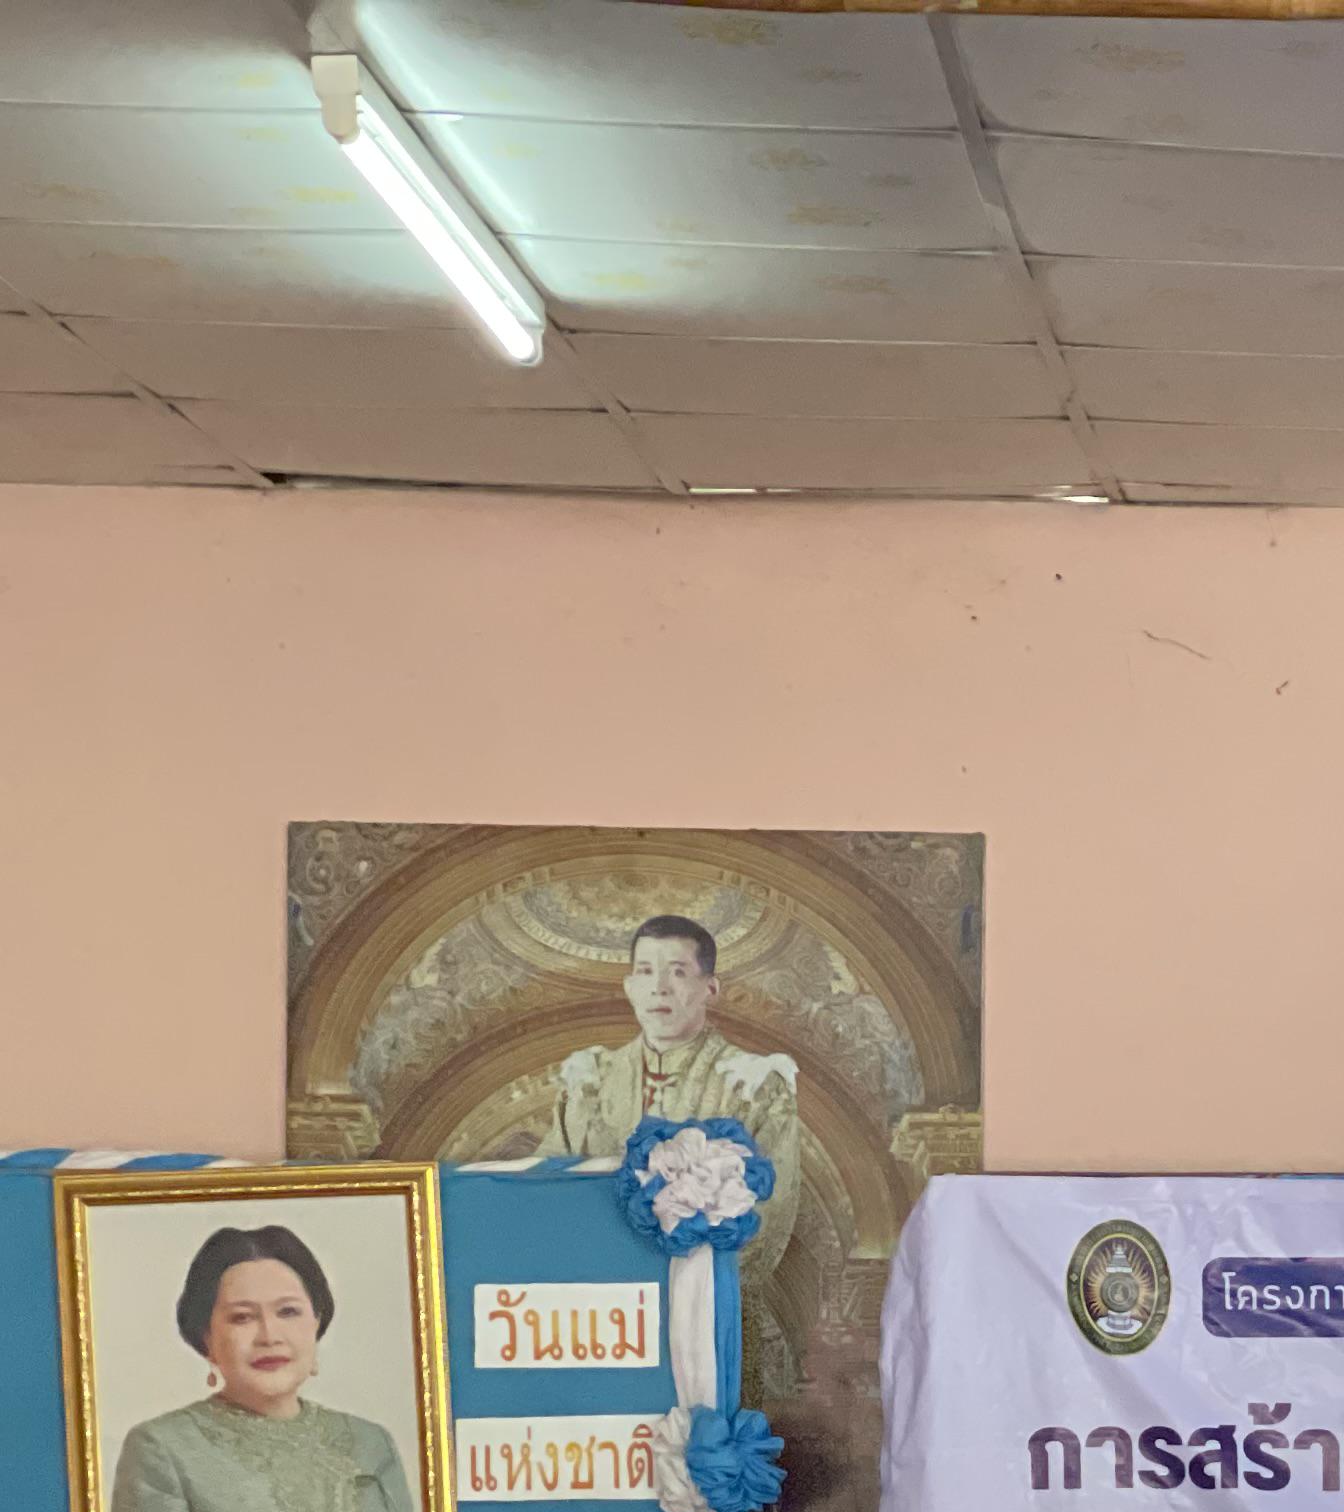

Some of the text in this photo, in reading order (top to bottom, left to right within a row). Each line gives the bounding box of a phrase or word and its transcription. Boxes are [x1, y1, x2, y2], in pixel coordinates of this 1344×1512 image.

[488, 1289, 646, 1362] วันแม่
[469, 1423, 654, 1492] แห่งชาติ
